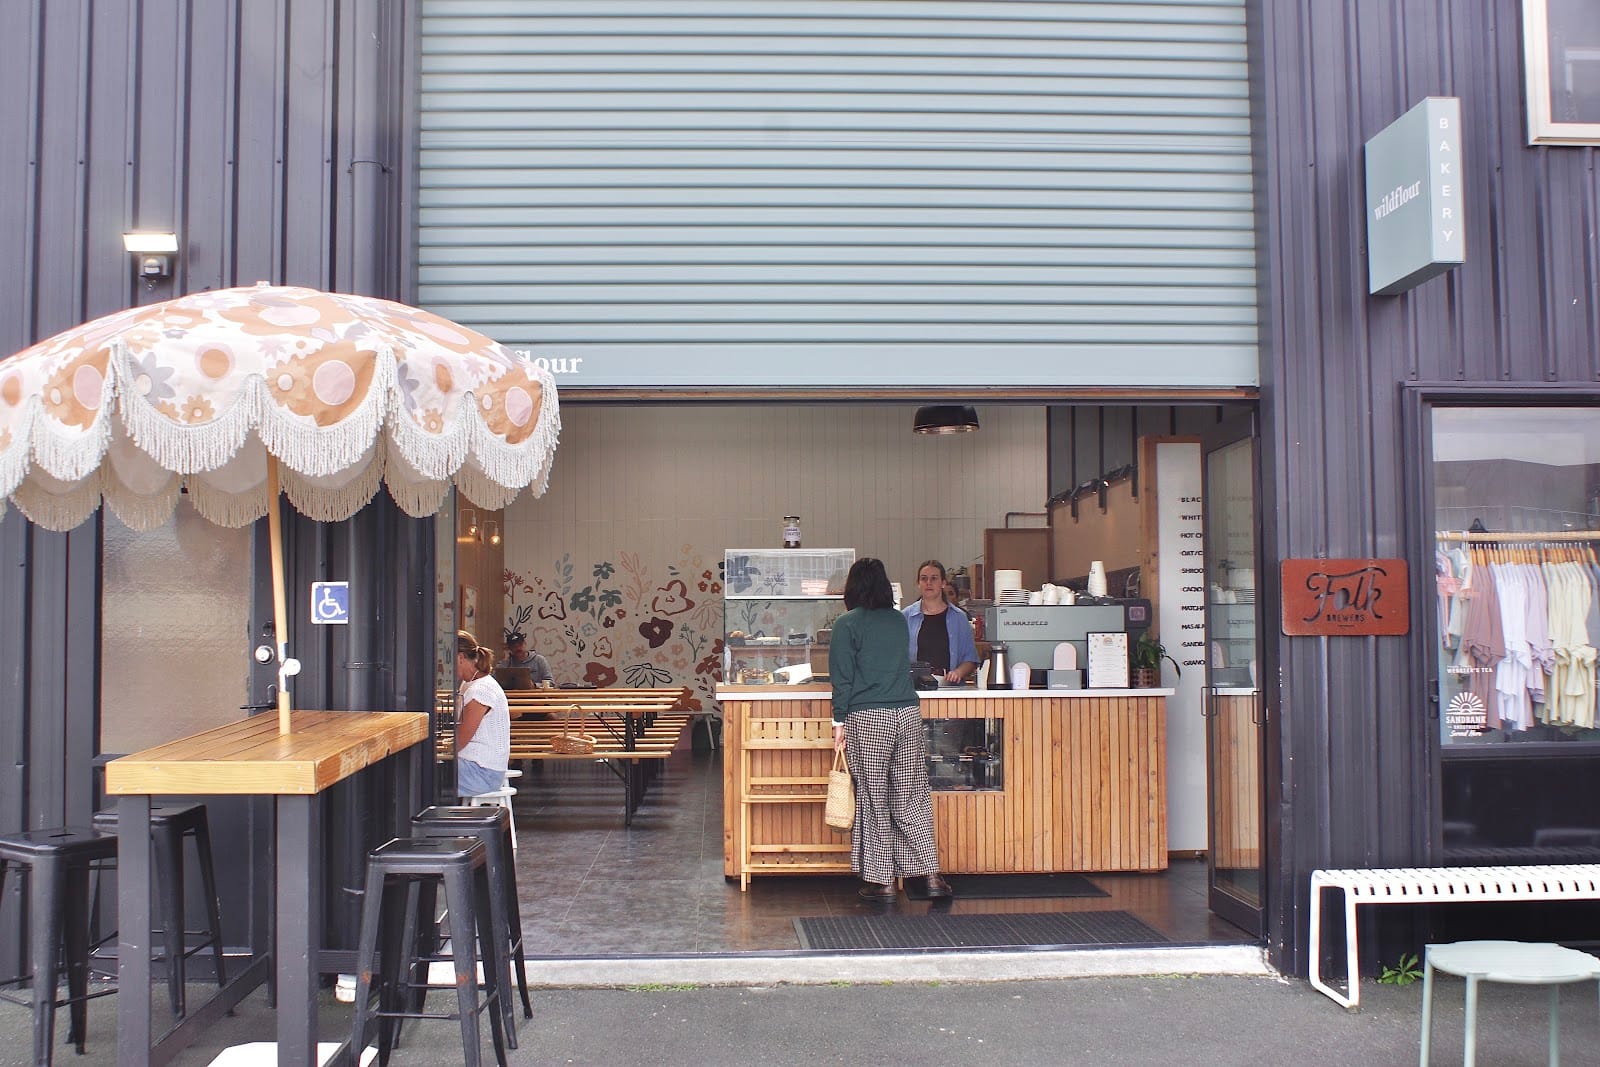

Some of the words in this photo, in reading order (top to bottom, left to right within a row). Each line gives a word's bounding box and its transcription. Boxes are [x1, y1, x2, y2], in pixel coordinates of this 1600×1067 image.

[1374, 180, 1421, 221] wildflour
[1439, 117, 1453, 242] BAKERY
[1302, 567, 1387, 622] Folk
[1326, 614, 1366, 622] BREWERS
